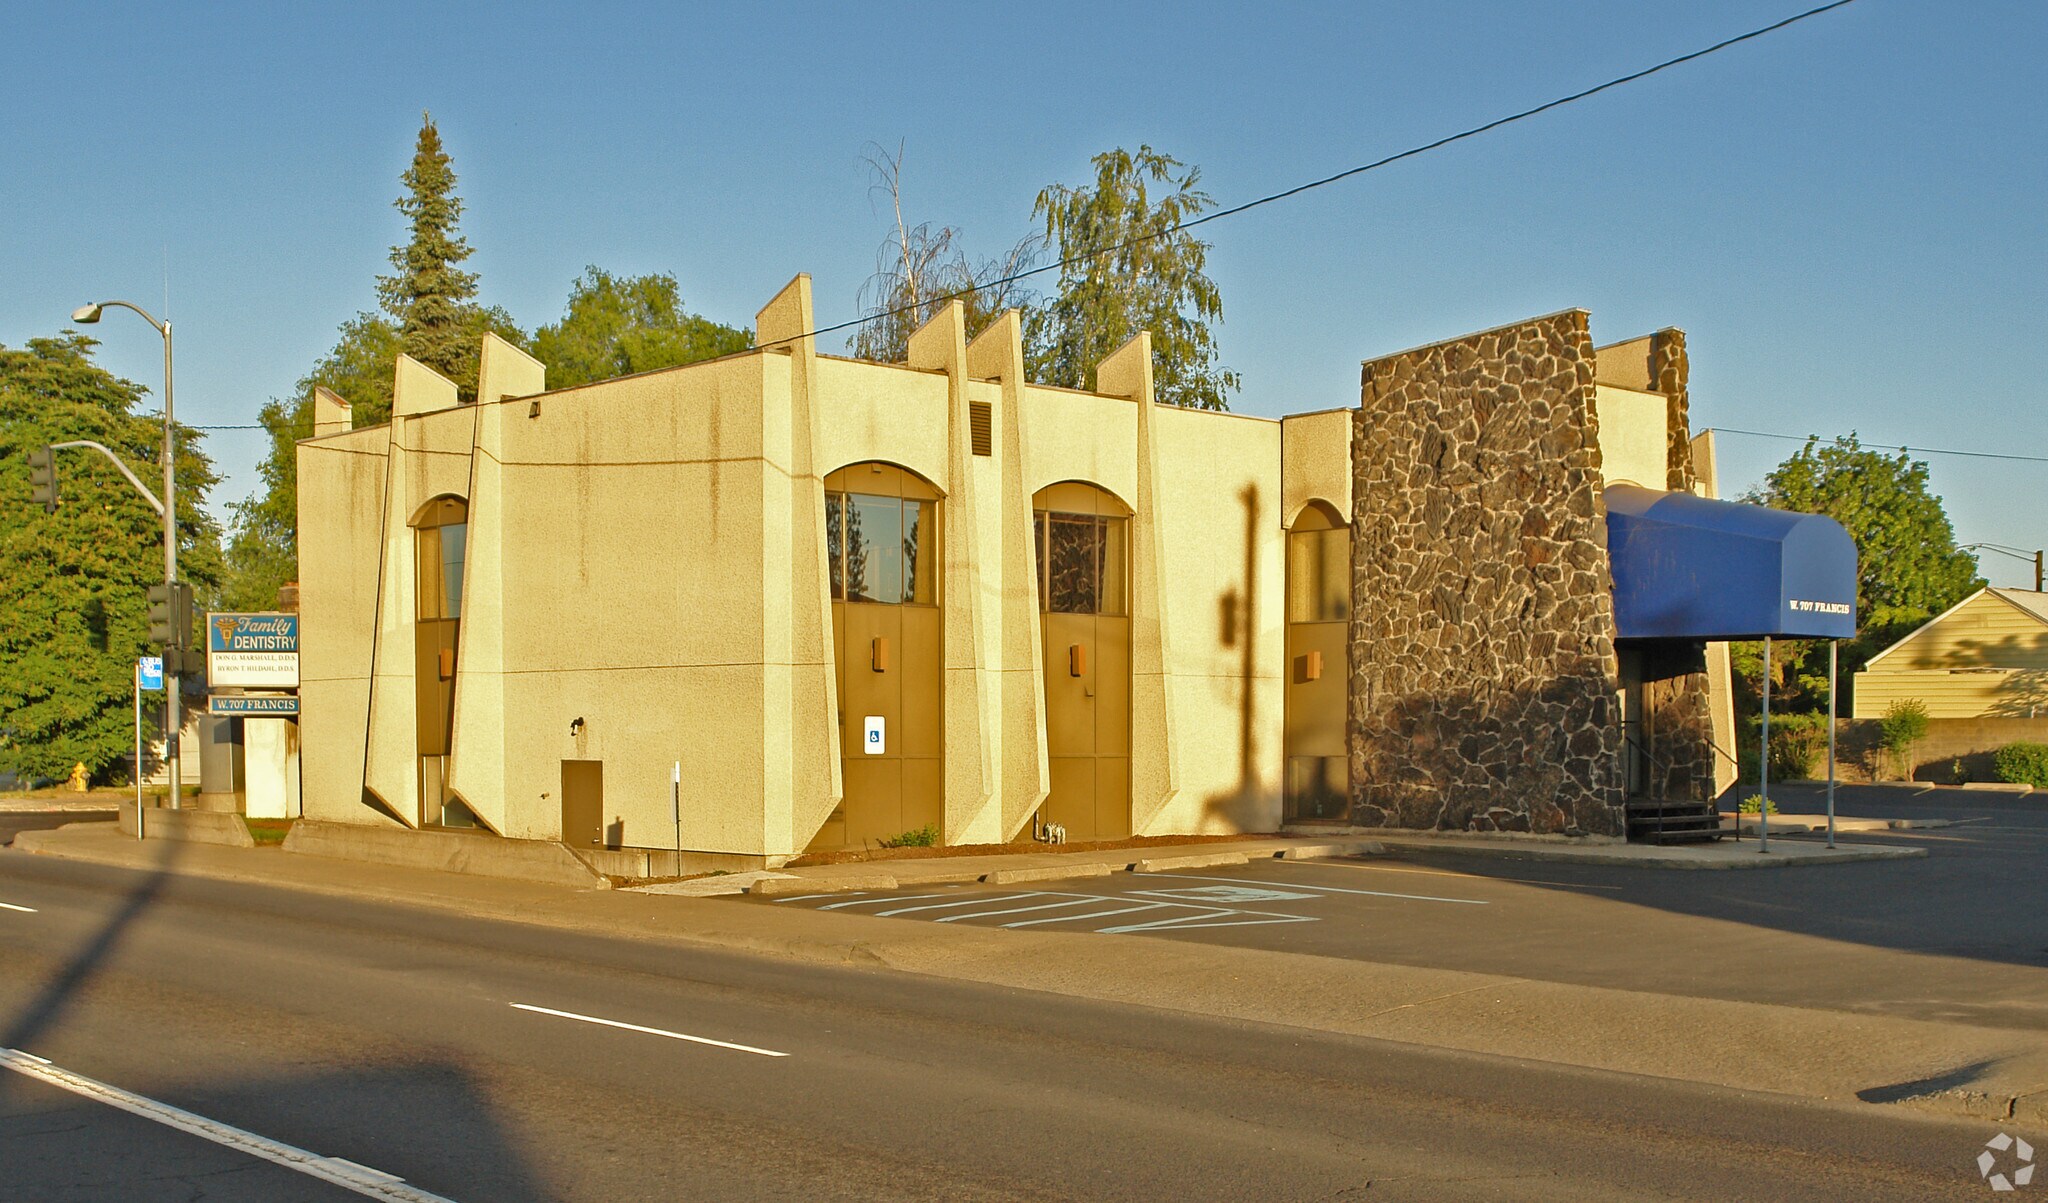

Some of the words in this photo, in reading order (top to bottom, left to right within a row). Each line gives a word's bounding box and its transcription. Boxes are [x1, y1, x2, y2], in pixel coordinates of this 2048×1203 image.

[1790, 600, 1799, 610] W.
[1799, 601, 1813, 611] 707
[1814, 602, 1850, 614] FRANCIS
[237, 616, 292, 636] Family
[234, 635, 296, 649] DENTISTRY
[217, 699, 228, 710] W.
[229, 699, 245, 710] 707
[246, 699, 296, 710] FRANCIS
